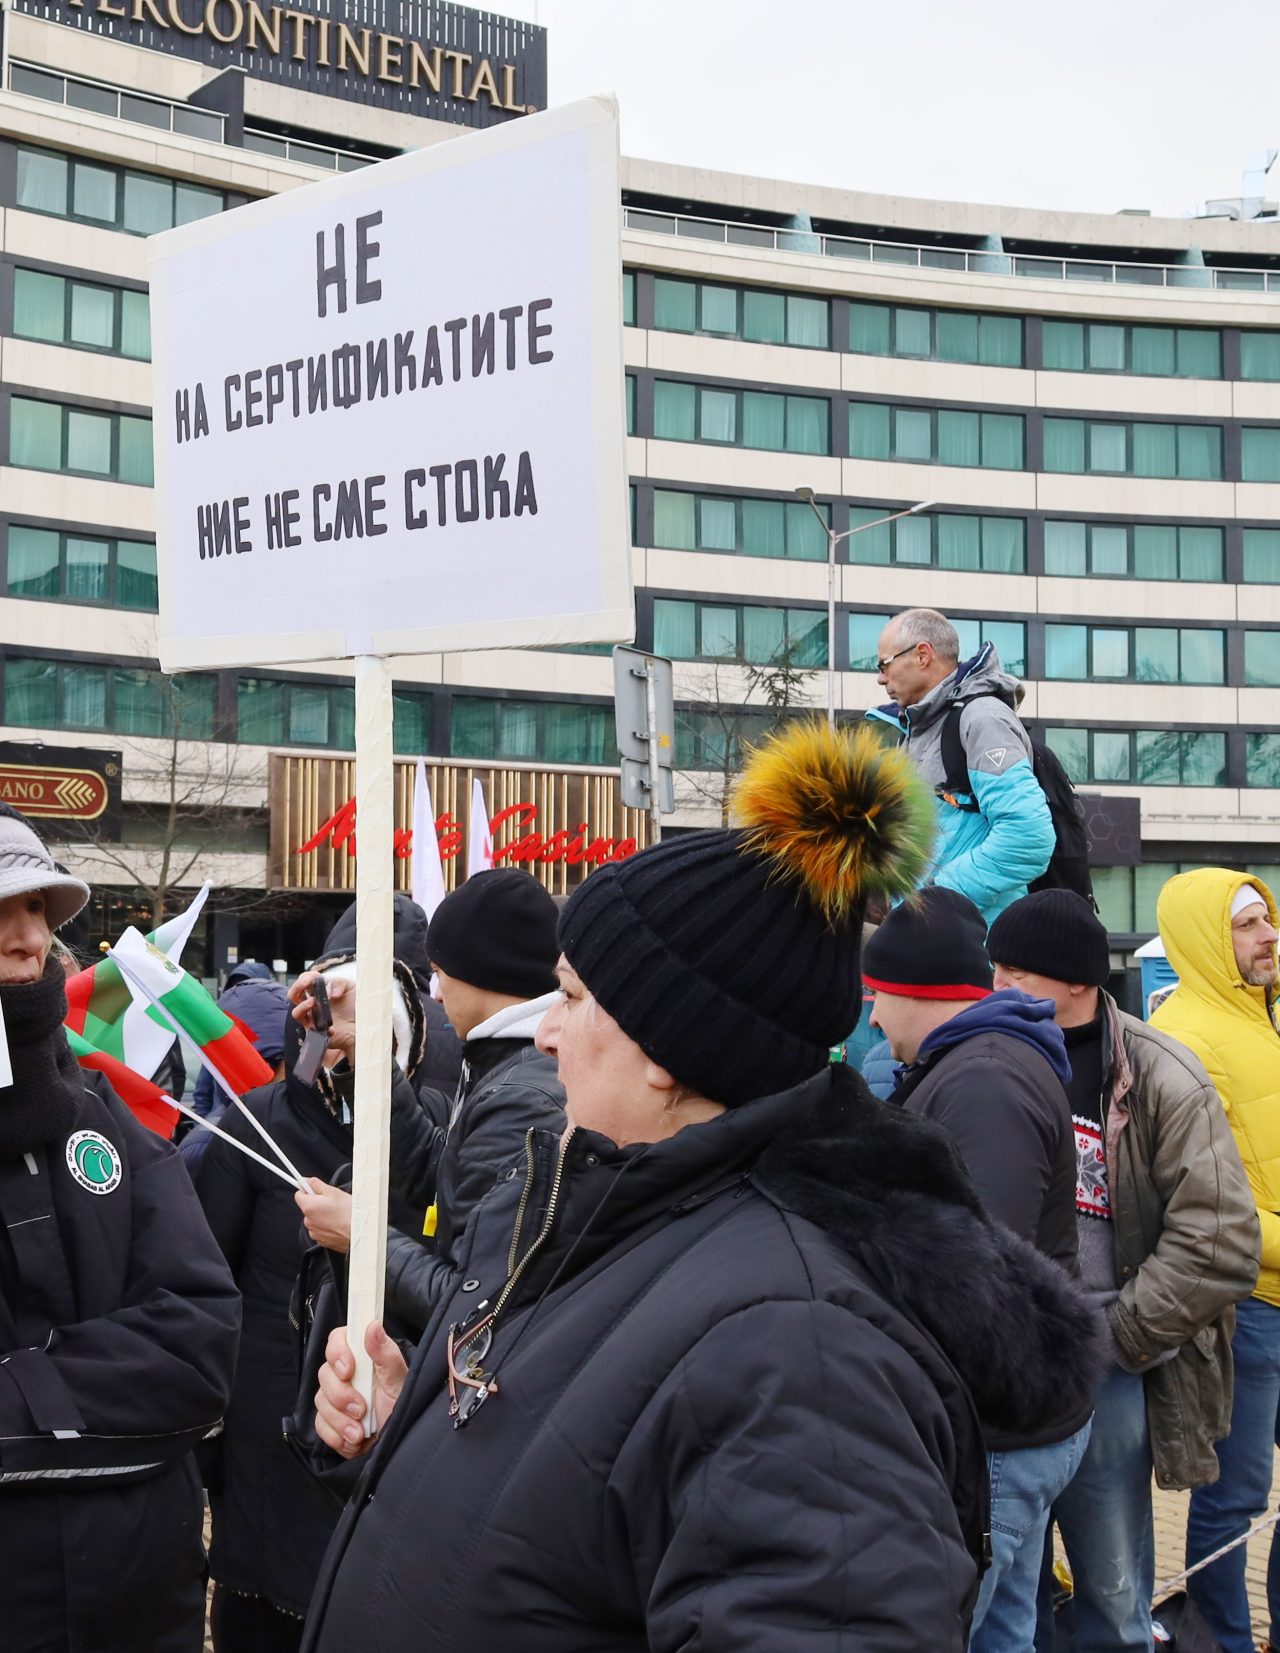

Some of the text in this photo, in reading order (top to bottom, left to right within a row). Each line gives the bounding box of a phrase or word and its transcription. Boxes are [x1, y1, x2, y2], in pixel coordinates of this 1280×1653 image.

[69, 0, 529, 113] RCONTINENTAL
[316, 209, 383, 318] НЕ
[175, 297, 554, 444] НА СЕРТИФИКАТИТЕ
[196, 450, 538, 561] НИЕ НЕ СМЕ СТОКА
[297, 797, 638, 867] Mne Casino
